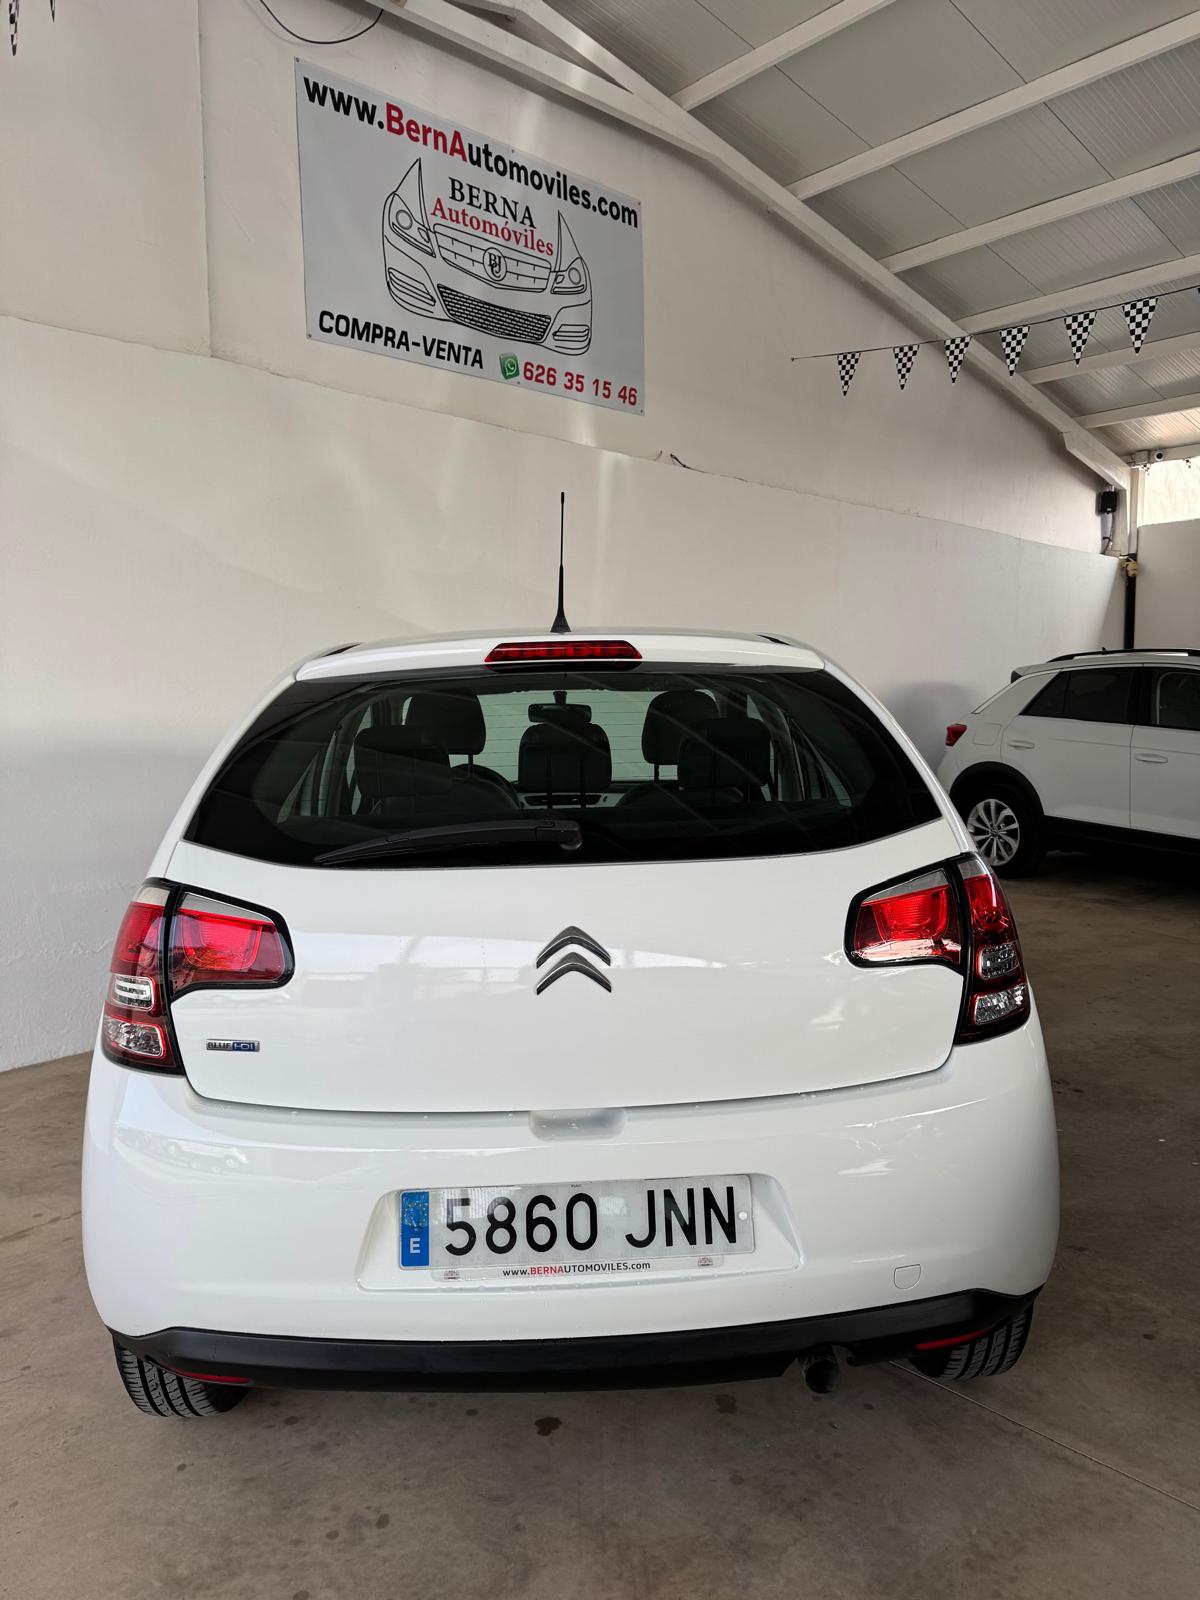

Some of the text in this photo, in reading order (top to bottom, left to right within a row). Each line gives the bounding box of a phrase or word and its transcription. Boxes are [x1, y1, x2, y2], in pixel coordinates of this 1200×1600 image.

[303, 76, 638, 228] www.BernAutomoviles.com
[431, 197, 554, 256] Automóviles
[449, 177, 537, 229] BERNA
[318, 310, 484, 370] COMPRA-VENTA
[522, 361, 638, 406] 626 35 15 46
[409, 1237, 421, 1254] E
[444, 1186, 737, 1256] 5860 JNN
[502, 1261, 651, 1277] www.BERNAUTOMOVILES.com
